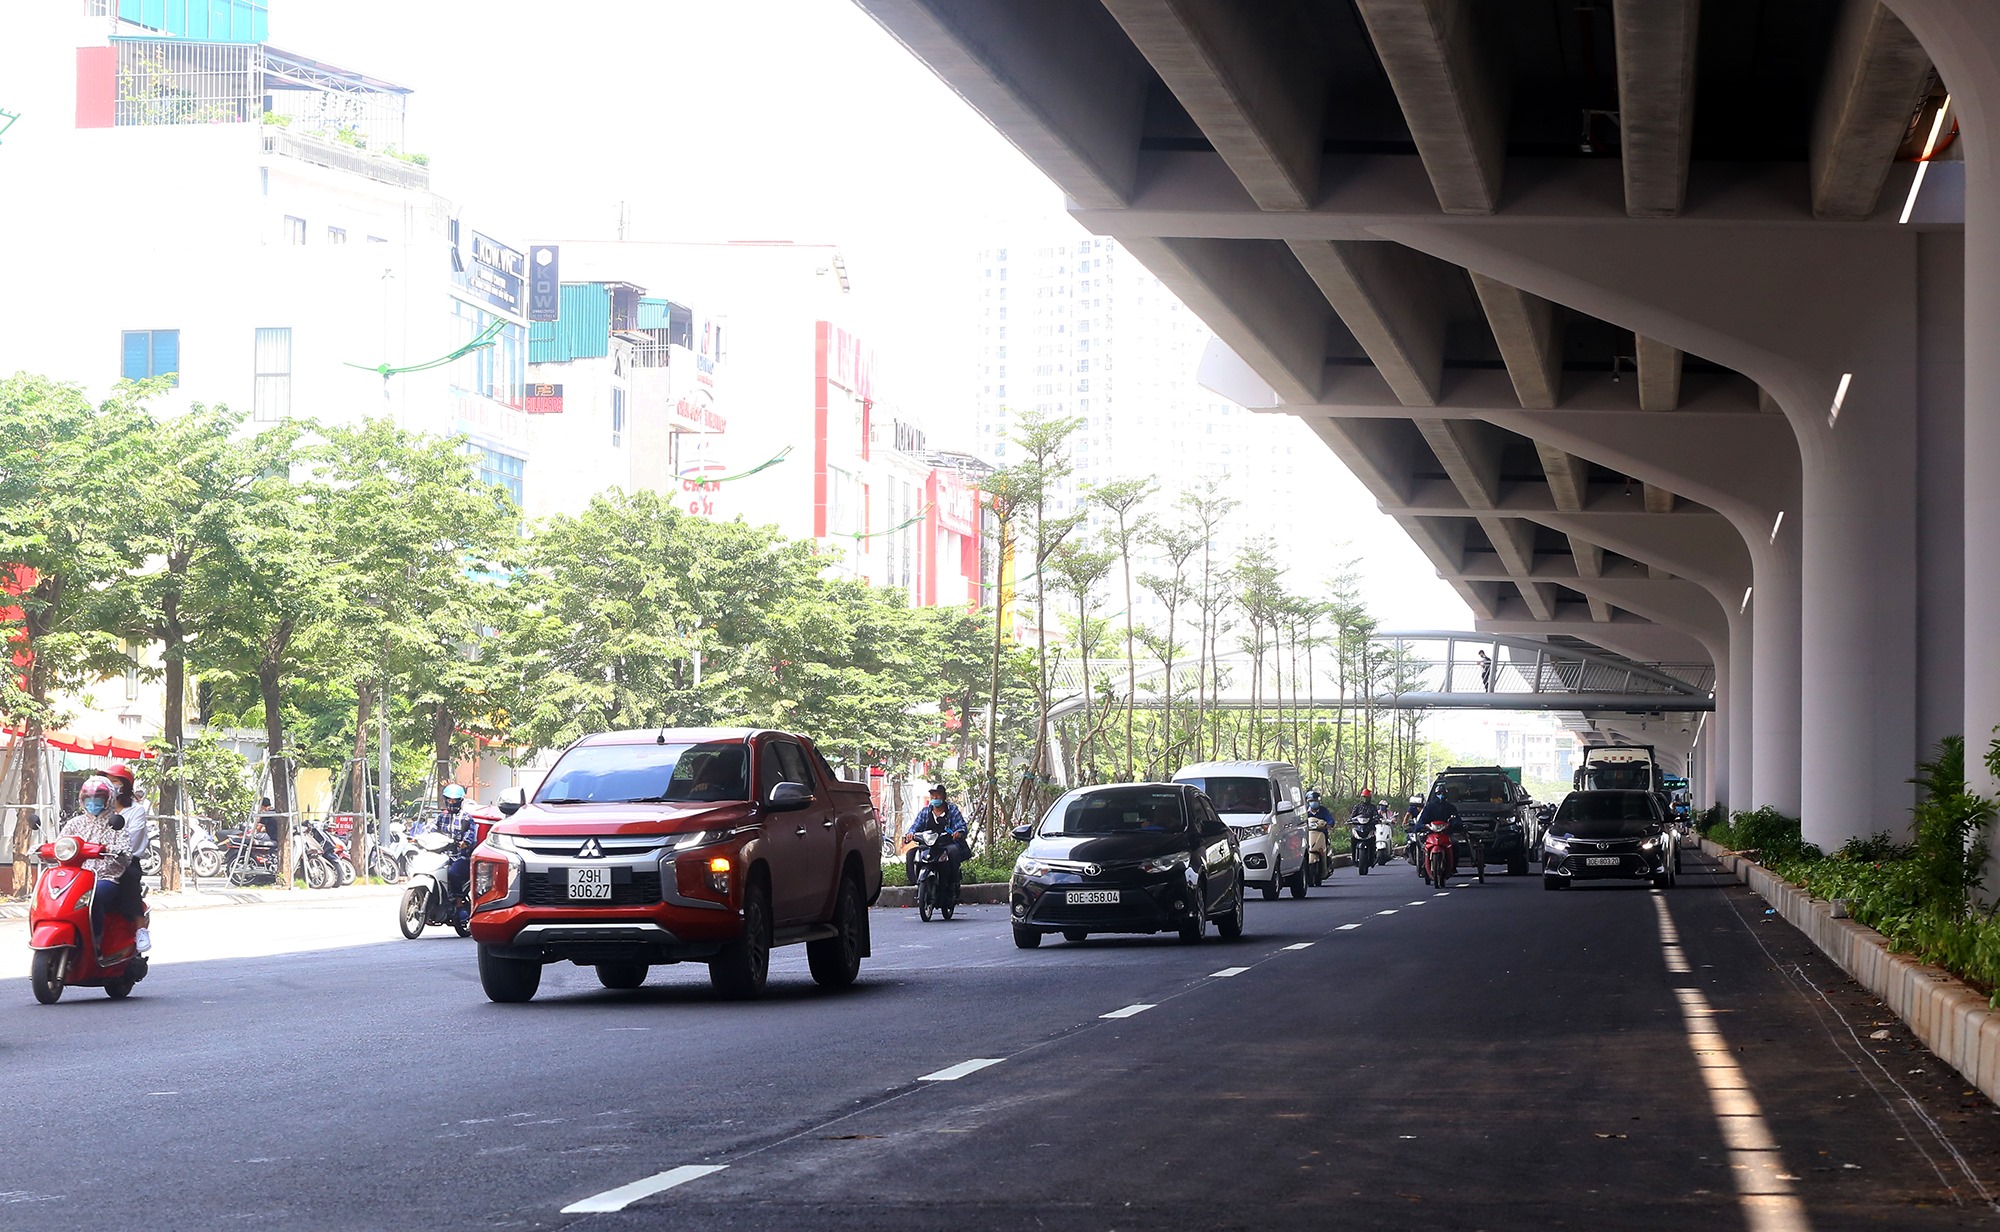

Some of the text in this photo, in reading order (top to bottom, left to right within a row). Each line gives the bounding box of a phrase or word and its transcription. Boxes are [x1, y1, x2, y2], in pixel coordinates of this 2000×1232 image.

[526, 397, 563, 412] BILLIARDS
[578, 869, 601, 883] 29H
[569, 884, 610, 898] 306.27
[1068, 892, 1118, 903] 30E-358.04
